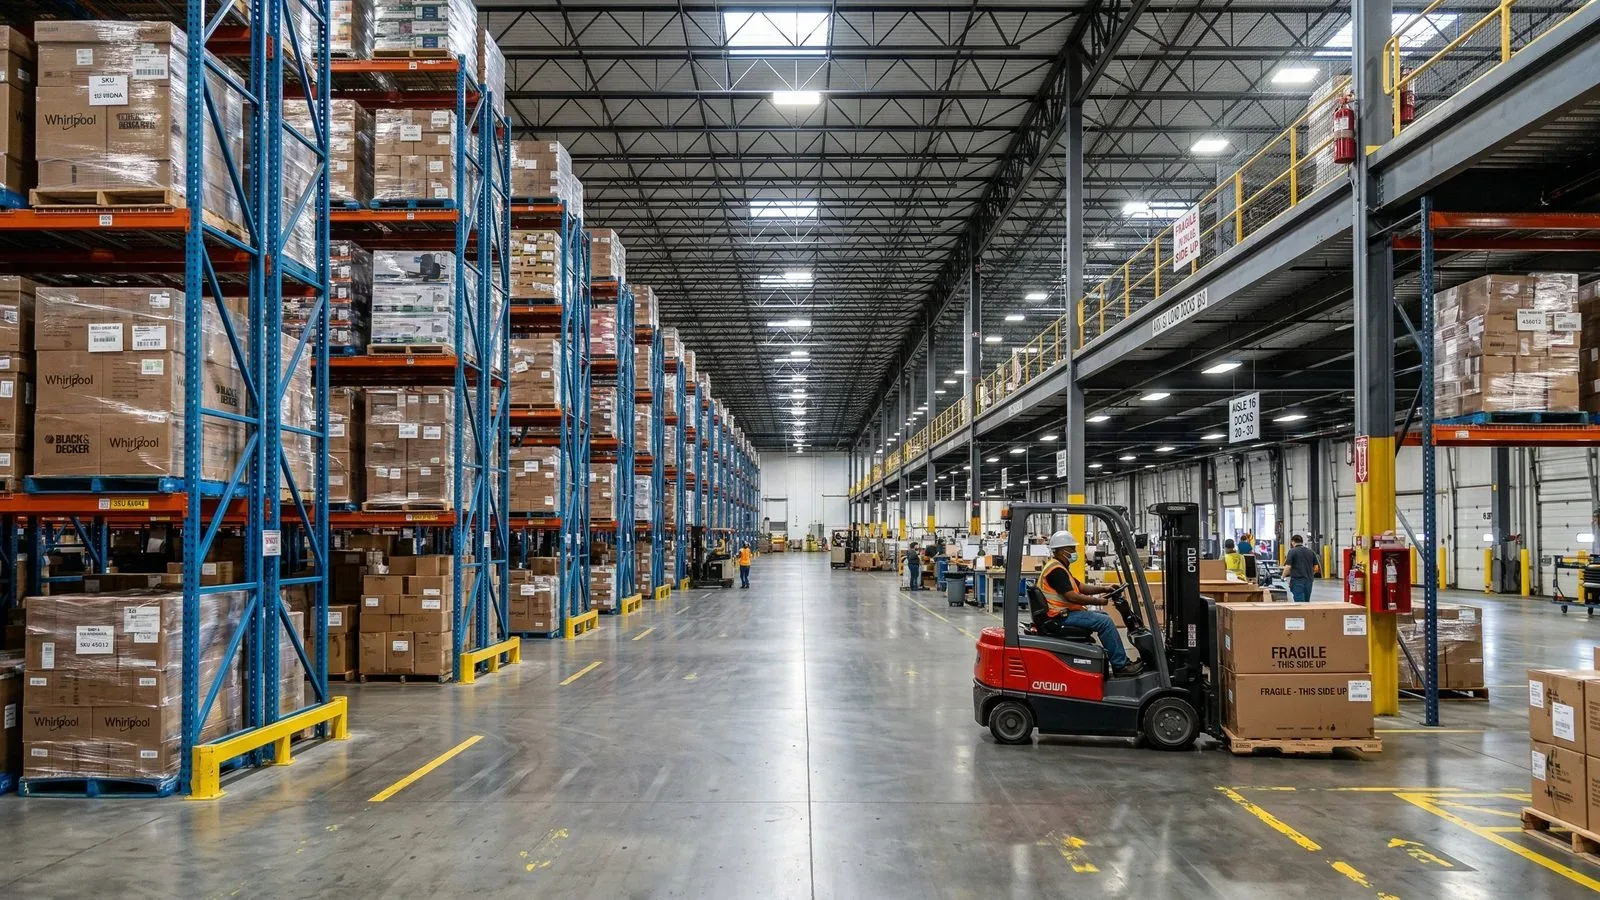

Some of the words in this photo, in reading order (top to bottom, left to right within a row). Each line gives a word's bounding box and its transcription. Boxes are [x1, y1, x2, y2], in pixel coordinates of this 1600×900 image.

[44, 113, 97, 130] Whirlpool
[1175, 246, 1188, 263] SIDE
[1189, 240, 1199, 254] UP
[45, 373, 94, 389] Whirlpool
[1248, 396, 1257, 409] 16
[1234, 426, 1242, 438] 20
[1246, 424, 1254, 436] 30
[55, 434, 90, 444] BLACK&
[109, 436, 159, 452] Whirlpool
[55, 444, 90, 454] DECKER
[1271, 646, 1327, 659] FRAGILE
[1278, 660, 1295, 669] THIS
[1296, 660, 1314, 669] SIDE
[1316, 660, 1327, 669] UP
[1260, 687, 1292, 696] FRAGILE
[1299, 687, 1316, 696] THIS
[1317, 687, 1335, 696] SIDE
[1337, 687, 1347, 696] UP
[34, 715, 79, 731] Whirlpool
[104, 715, 151, 732] Whirlpool
